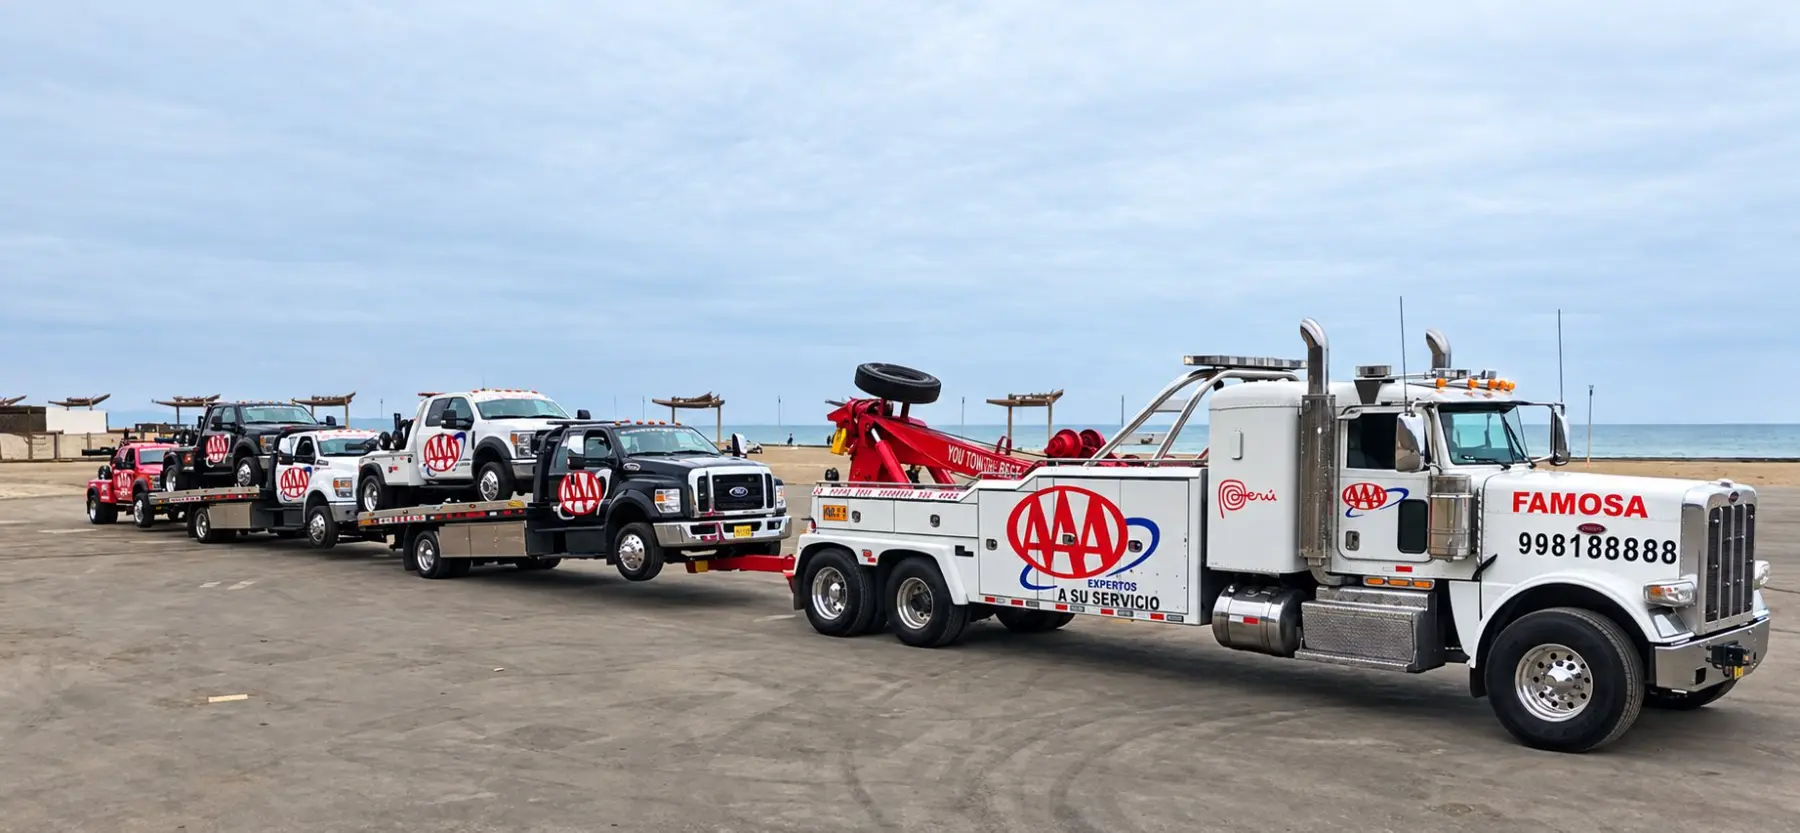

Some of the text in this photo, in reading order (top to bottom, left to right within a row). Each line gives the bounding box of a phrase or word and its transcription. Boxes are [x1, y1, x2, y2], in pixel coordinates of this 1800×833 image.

[425, 434, 459, 471] AAA
[948, 444, 965, 465] YOU
[966, 451, 984, 472] TOW
[282, 467, 308, 497] AAA
[560, 471, 601, 514] AAA
[1345, 483, 1385, 509] AAA
[1218, 479, 1277, 519] Perú
[1512, 491, 1648, 518] FAMOSA
[1014, 487, 1122, 578] AAA
[1518, 532, 1677, 564] 998188888
[1058, 588, 1159, 610] A SU SERVICIO
[1088, 579, 1137, 592] EXPERTOS
